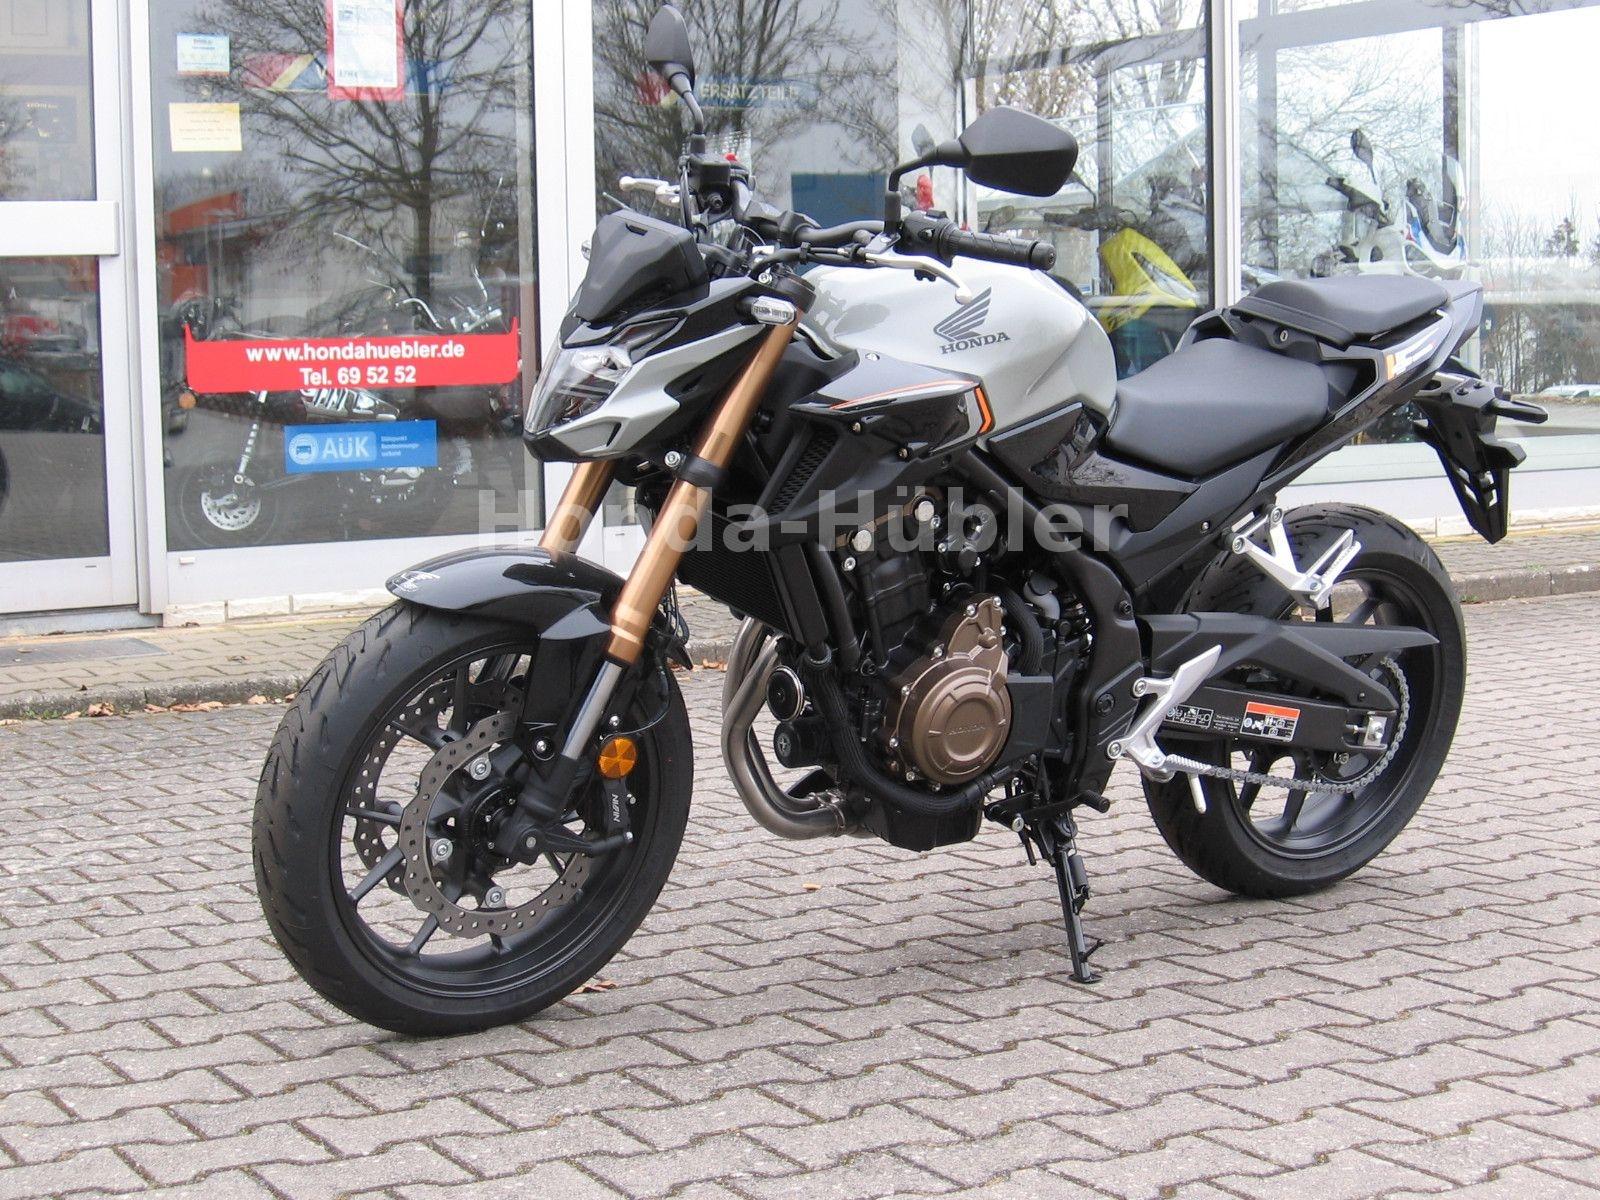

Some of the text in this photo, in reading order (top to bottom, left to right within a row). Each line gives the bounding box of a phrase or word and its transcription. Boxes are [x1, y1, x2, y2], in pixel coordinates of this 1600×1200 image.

[246, 340, 465, 362] www.hondahuebler.de
[940, 332, 1010, 354] HONDA
[299, 365, 416, 386] Tel. 69 52 52
